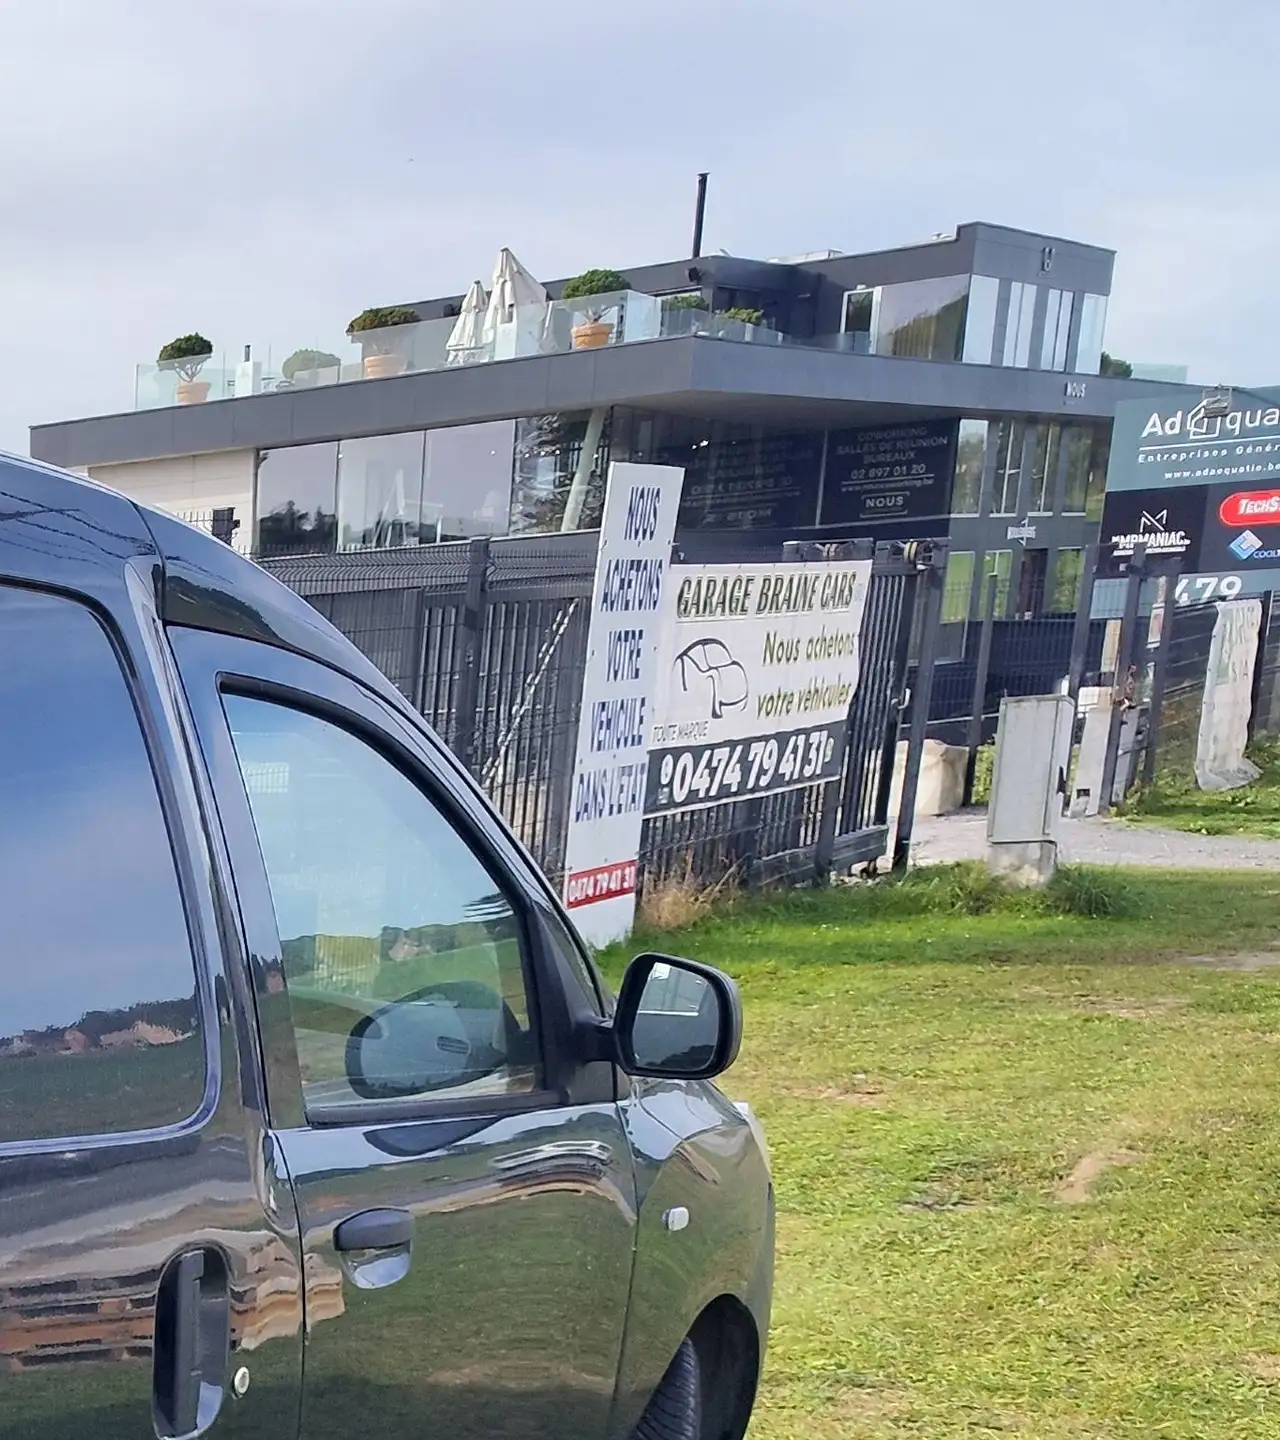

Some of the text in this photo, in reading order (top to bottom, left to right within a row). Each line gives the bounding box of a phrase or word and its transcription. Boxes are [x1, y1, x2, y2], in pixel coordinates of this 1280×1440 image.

[850, 469, 866, 480] 02
[892, 465, 907, 476] 01
[910, 463, 926, 474] 20
[1138, 448, 1228, 463] Entreprises
[624, 486, 661, 540] NOUS
[865, 496, 904, 508] NOUS
[1253, 549, 1280, 558] COOL
[601, 559, 663, 612] ACHETONS
[676, 571, 856, 619] GARAGE BRAINE CARS
[607, 629, 643, 682] VOTRE
[762, 624, 855, 667] Nous achetons
[591, 697, 646, 752] VEHICULE
[756, 687, 792, 720] votre
[652, 719, 709, 744] TOUTE MARQUE
[673, 730, 828, 803] 0474 79 41 31
[575, 770, 607, 823] DANS
[569, 866, 636, 902] 0474 79 41 31
